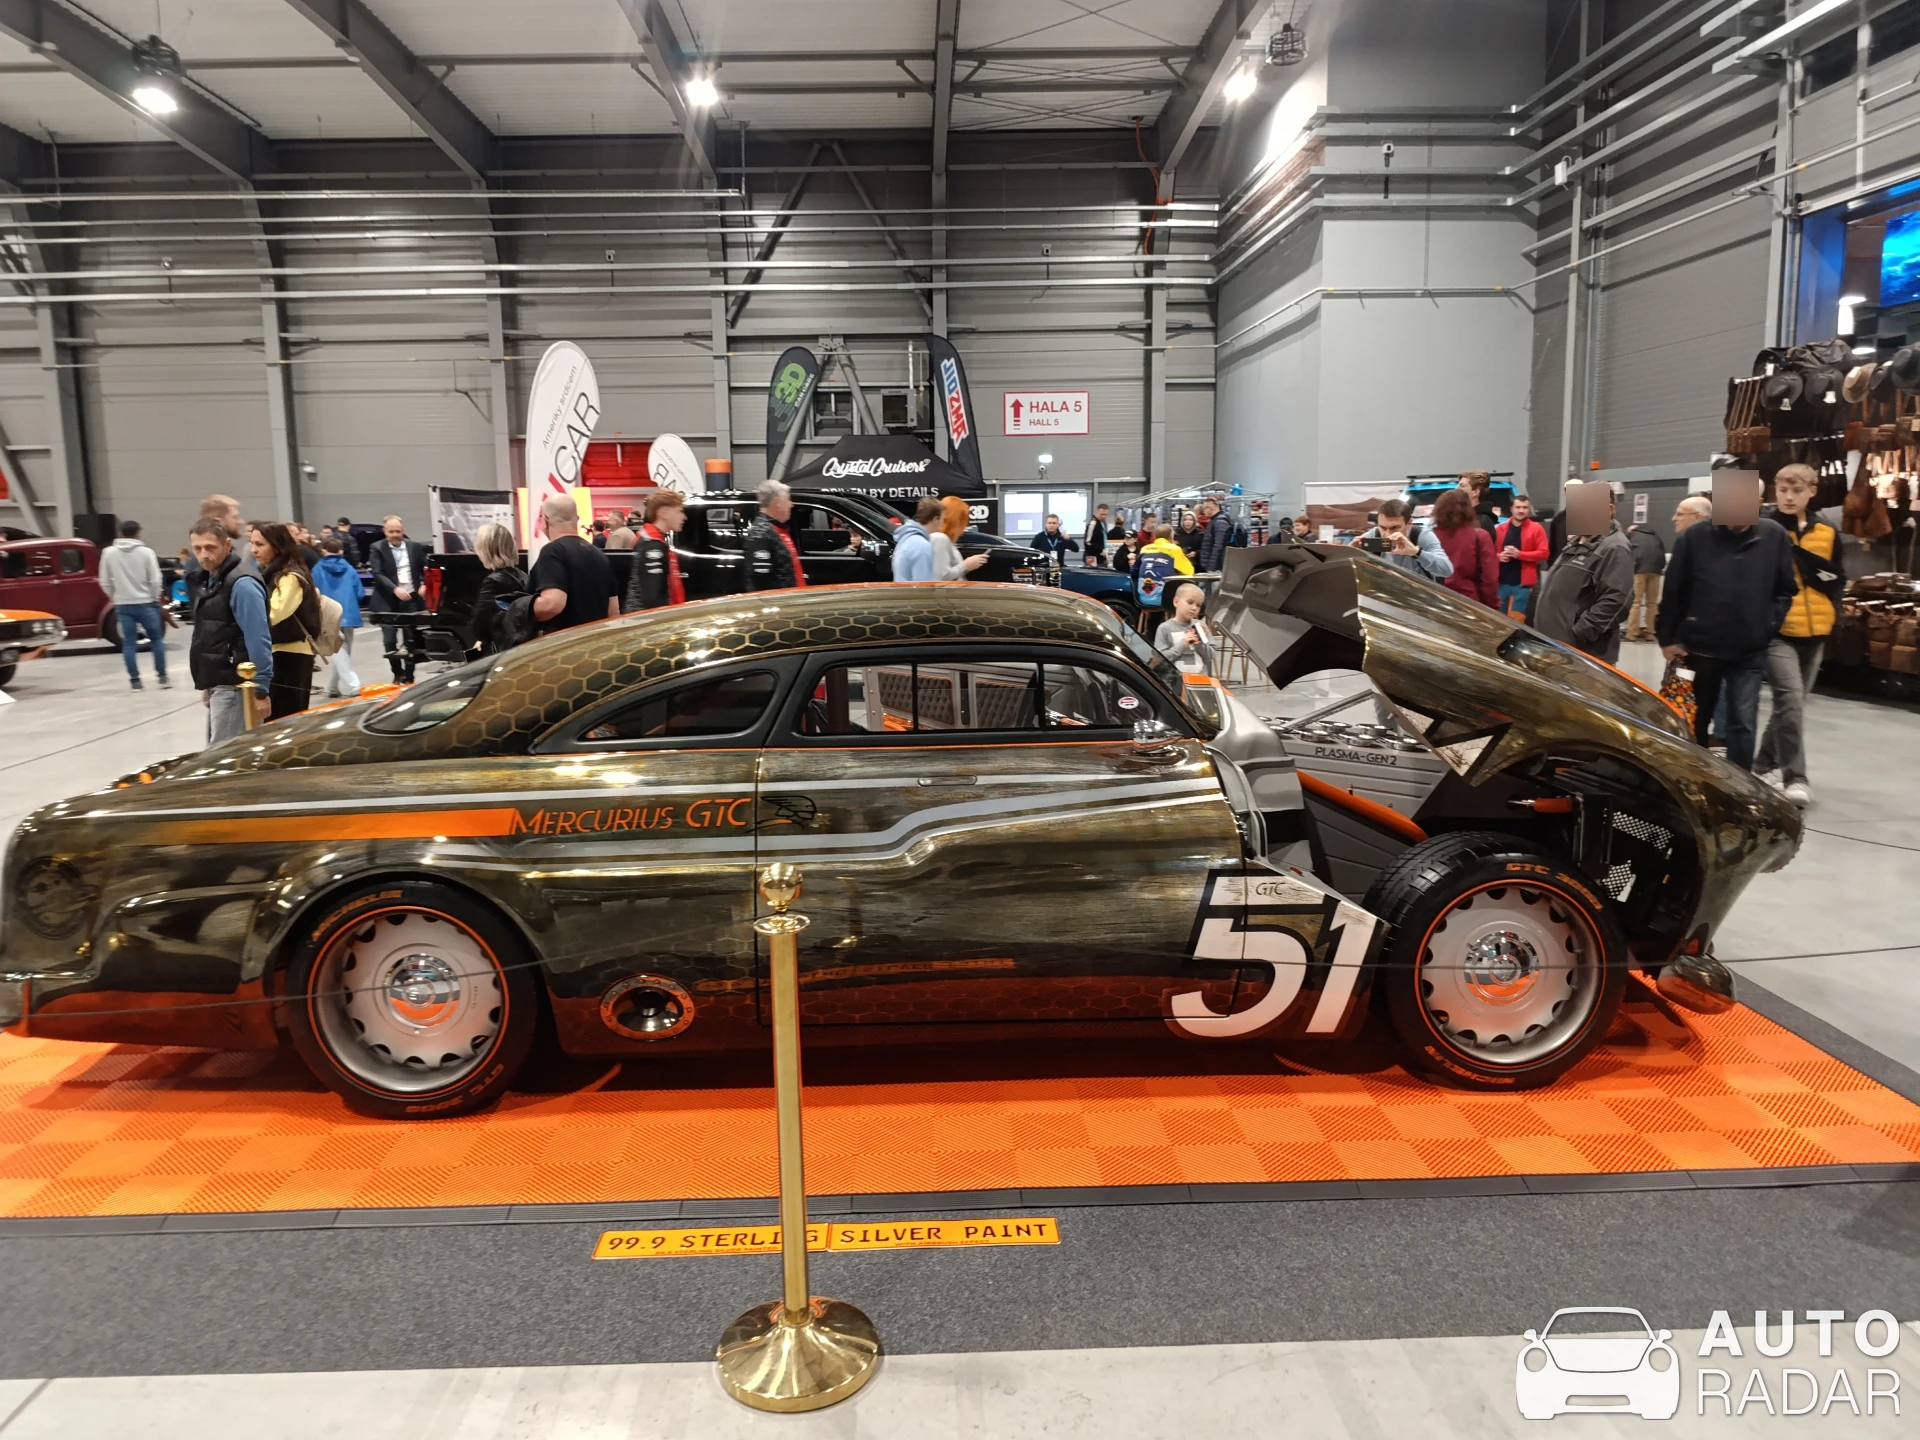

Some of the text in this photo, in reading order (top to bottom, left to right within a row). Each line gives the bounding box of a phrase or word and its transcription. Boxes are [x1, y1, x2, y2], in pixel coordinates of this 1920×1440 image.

[775, 362, 806, 404] 3D
[543, 365, 578, 450] Ameriky srdcem
[1029, 400, 1082, 413] HALA 5
[1029, 418, 1060, 426] HALL 5
[869, 488, 886, 498] BY
[889, 486, 939, 498] DETAILS
[968, 505, 989, 520] 3D
[685, 797, 752, 828] GTC
[1255, 882, 1286, 896] GTC
[1171, 876, 1378, 1038] 51
[609, 1230, 818, 1250] 99.9 STERLIG
[840, 1224, 1047, 1243] SILVER PAINT
